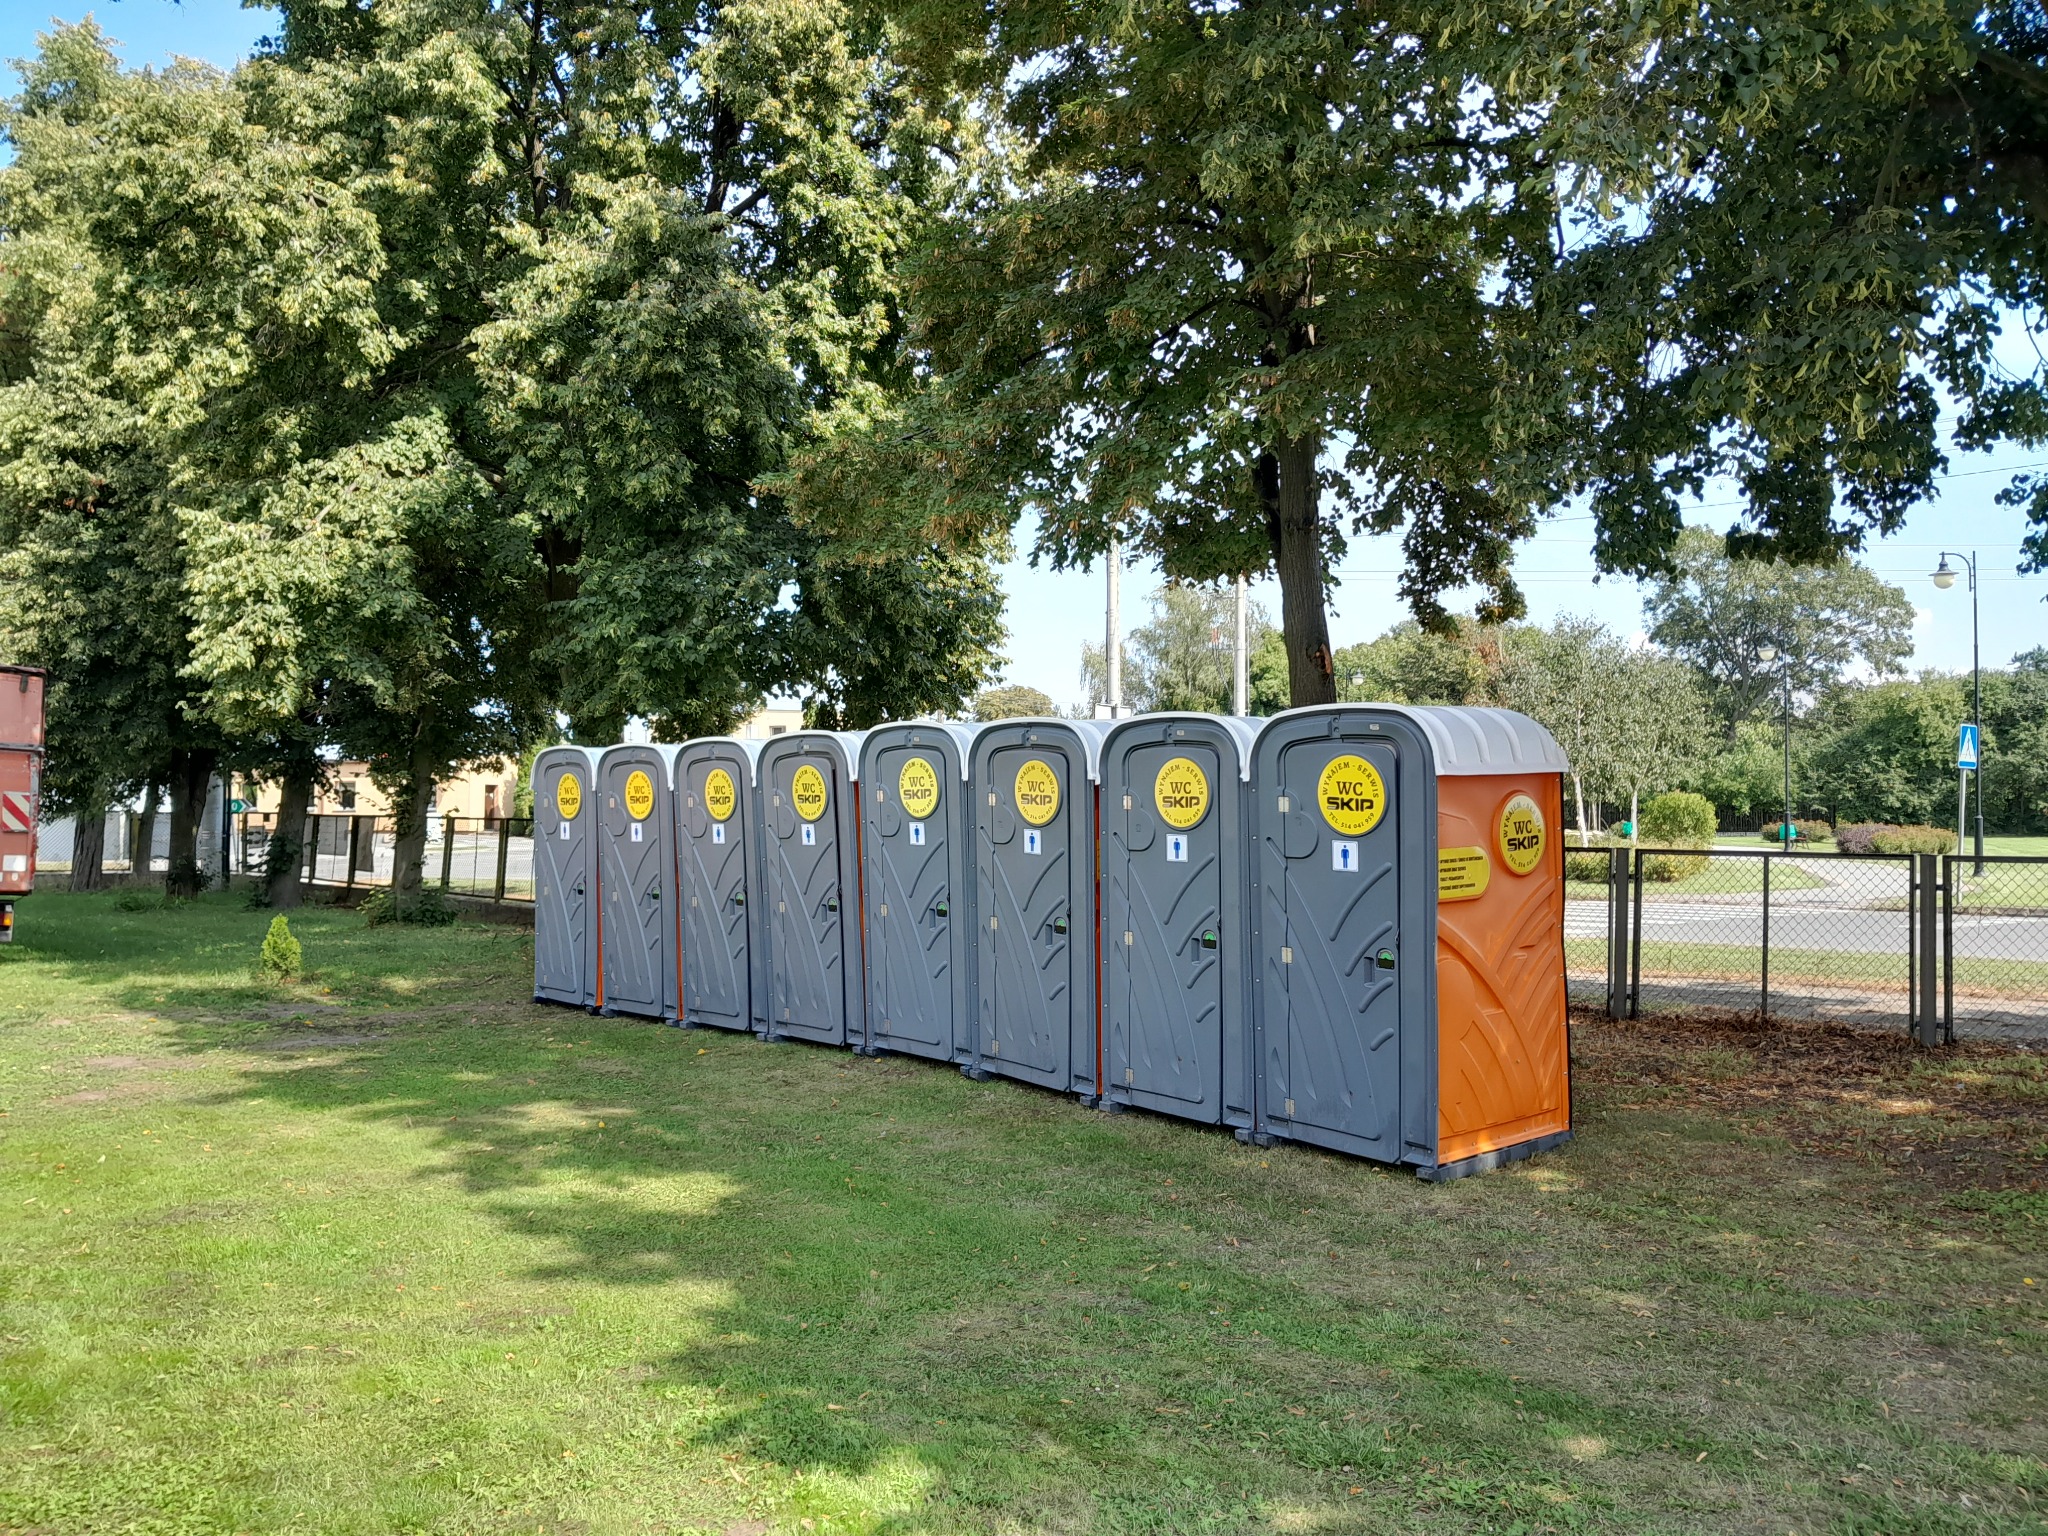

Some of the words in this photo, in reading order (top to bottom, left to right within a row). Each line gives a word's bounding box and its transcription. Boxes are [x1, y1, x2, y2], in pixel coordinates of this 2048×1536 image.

[908, 776, 925, 788] WC
[1158, 764, 1180, 796] WYNAJEM
[1186, 766, 1204, 796] SERWIS
[1322, 761, 1350, 796] WYNAJEM
[1357, 764, 1380, 798] SERWIS
[713, 786, 726, 795] WC
[802, 782, 816, 794] WC
[1027, 780, 1045, 793] WC
[1170, 782, 1192, 794] WC
[1336, 781, 1363, 796] WC
[630, 796, 650, 804] SKIP
[798, 794, 821, 804] SKIP
[903, 788, 932, 800] SKIP
[1020, 793, 1052, 806] SKIP
[710, 796, 730, 806] SKIP
[1162, 796, 1200, 808] SKIP
[1326, 796, 1374, 812] SKIP
[1328, 812, 1340, 824] TEL.
[1365, 812, 1374, 824] 959
[1513, 820, 1532, 835] WC
[1507, 834, 1540, 852] SKIP
